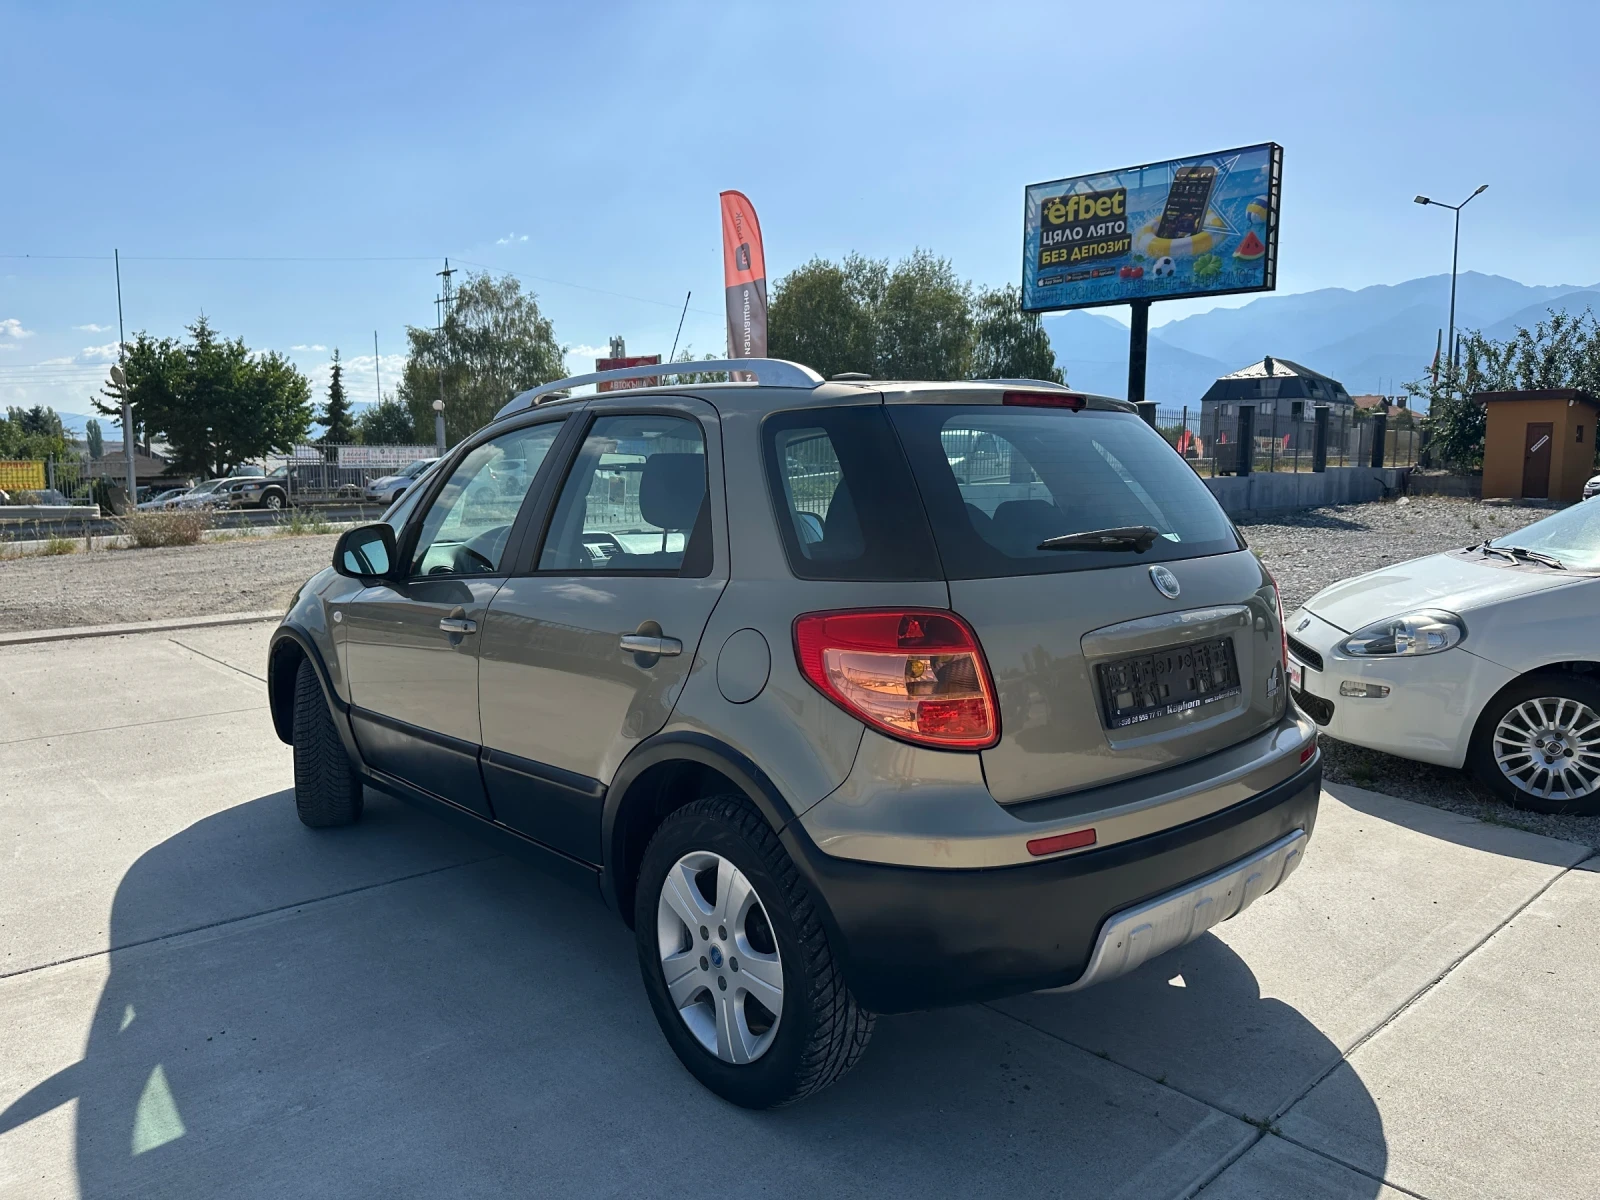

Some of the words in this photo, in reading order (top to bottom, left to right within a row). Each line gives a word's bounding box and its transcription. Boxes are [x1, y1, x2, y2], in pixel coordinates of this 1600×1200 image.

[1047, 191, 1124, 225] efbet
[1042, 226, 1083, 246] ЦЯЛО
[1086, 219, 1125, 238] ЛЯТО
[1041, 248, 1068, 265] БЕЗ
[1070, 238, 1131, 261] ДЕПОЗИТ
